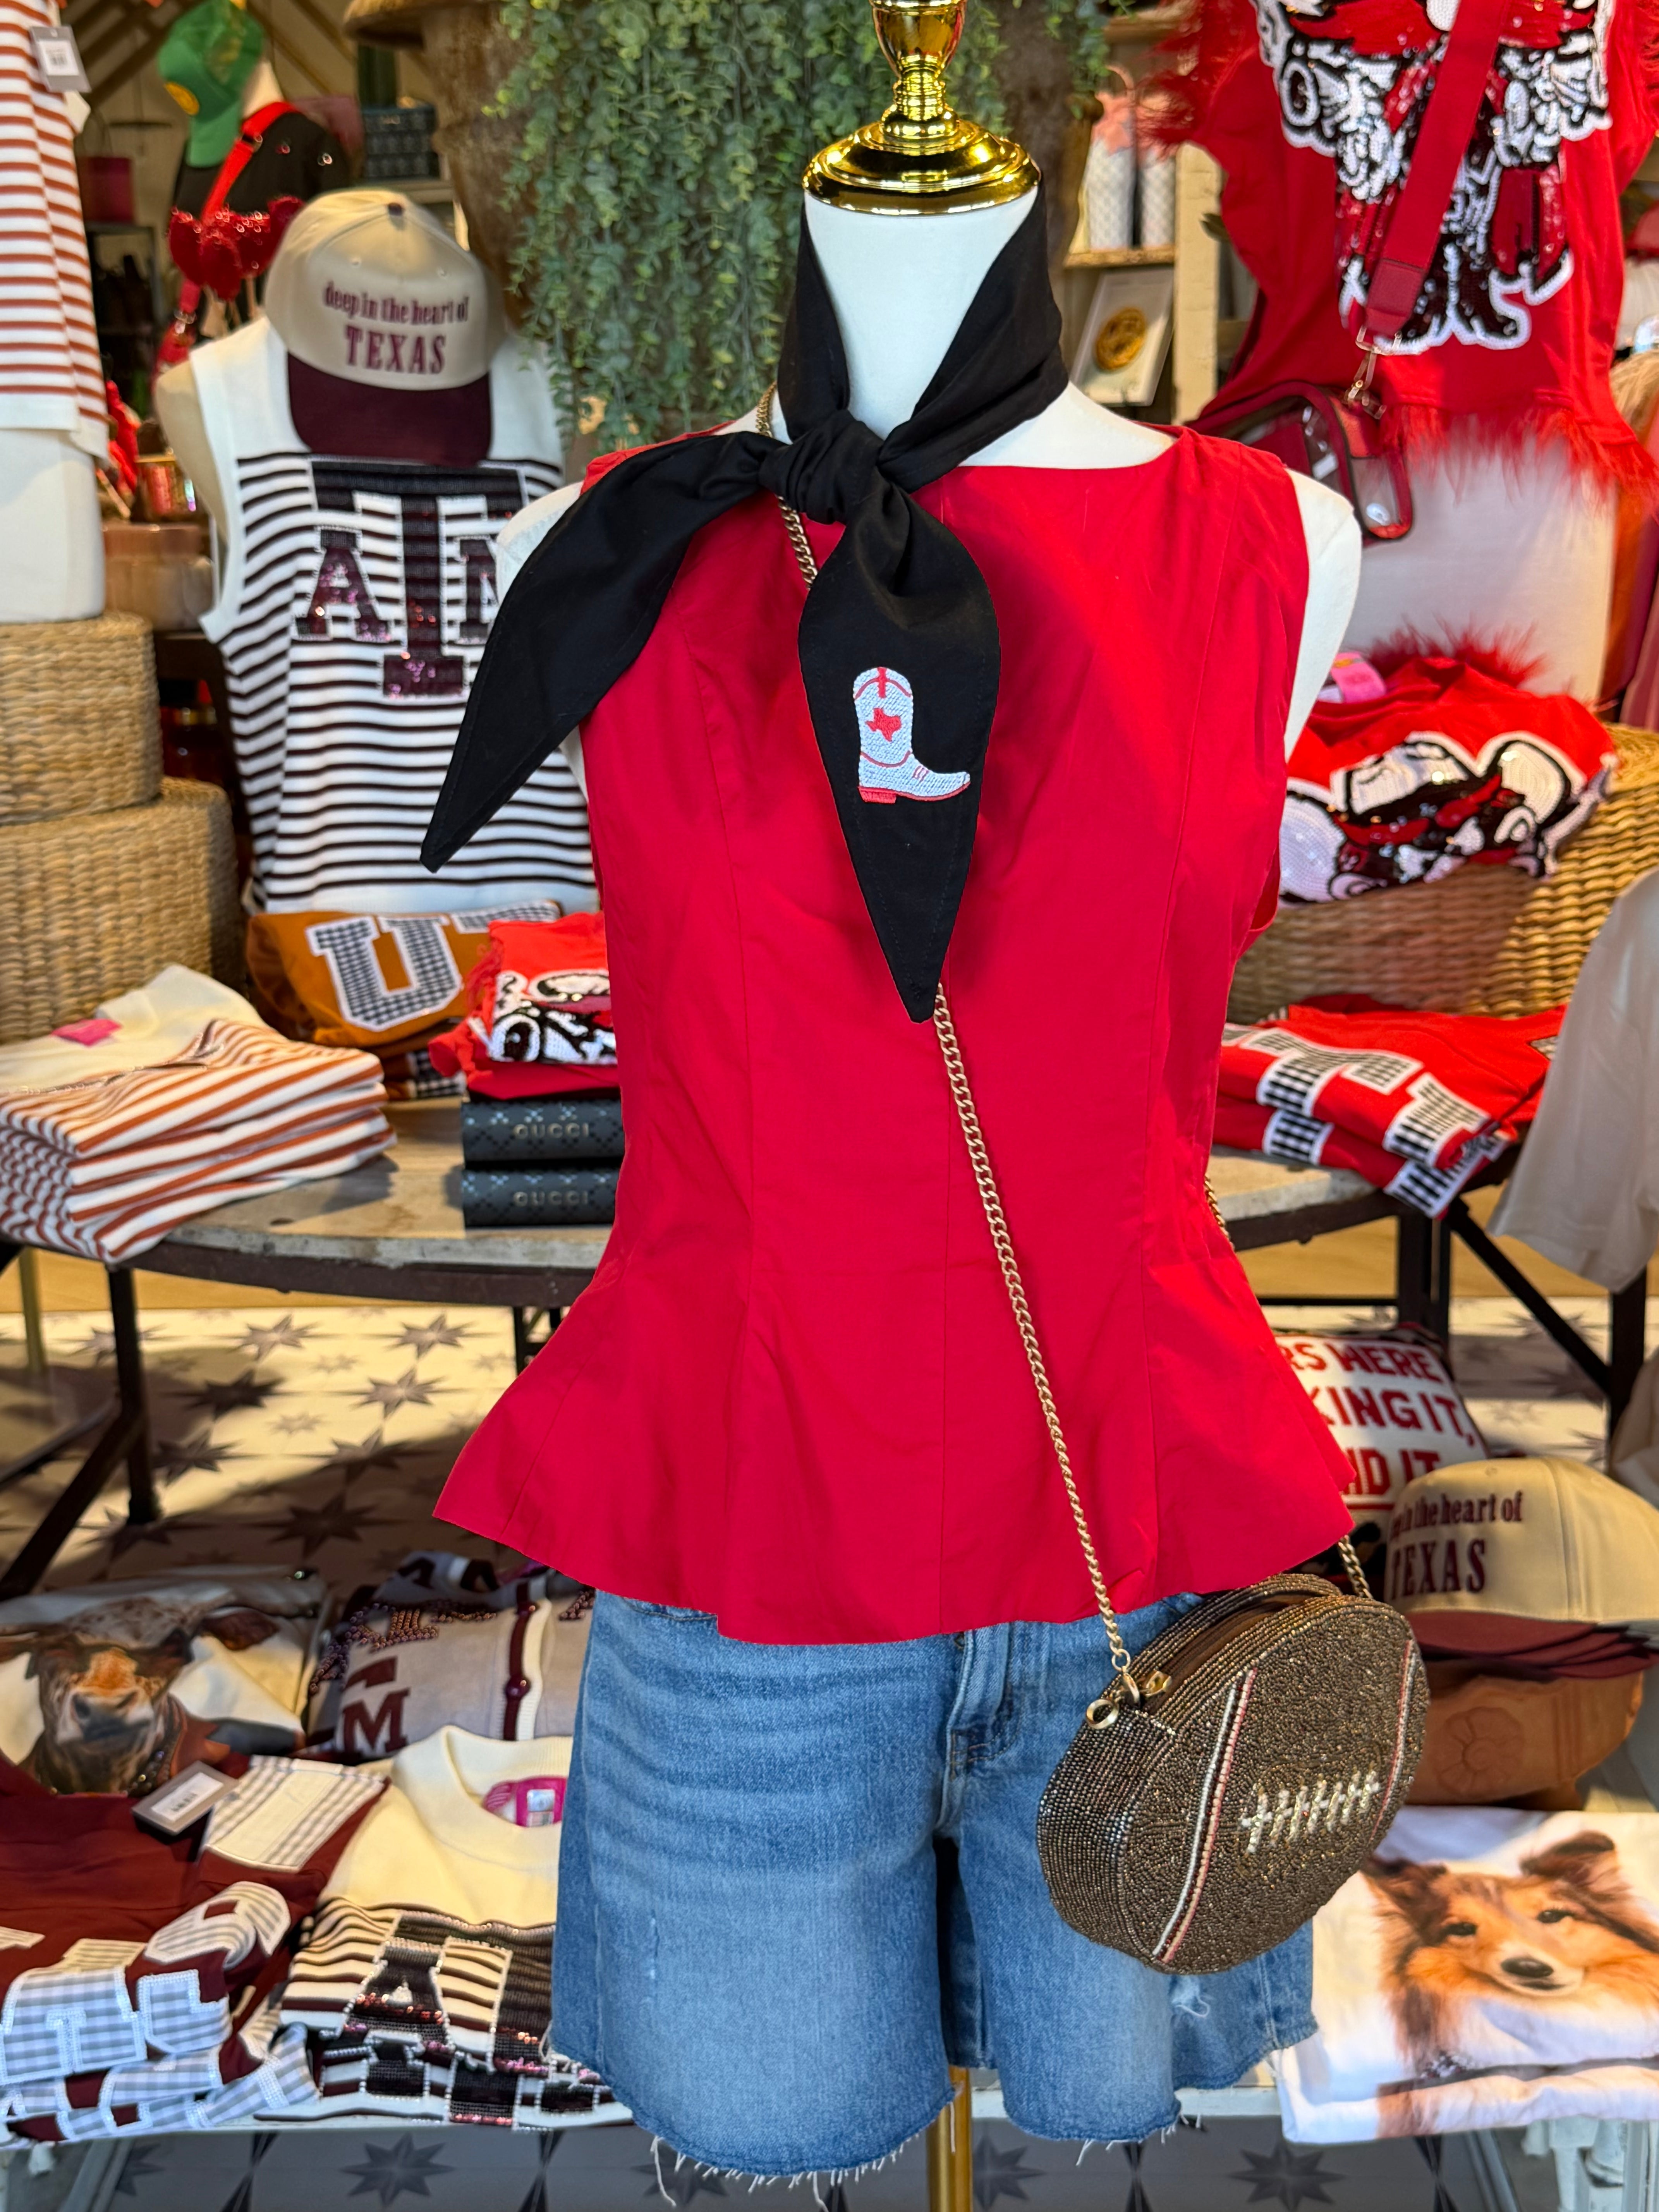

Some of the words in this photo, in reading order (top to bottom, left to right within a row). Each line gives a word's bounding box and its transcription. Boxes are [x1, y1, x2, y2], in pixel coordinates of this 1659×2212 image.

[324, 281, 359, 319] deep
[361, 292, 378, 320] in
[381, 297, 409, 323] the
[411, 299, 454, 325] heart
[345, 325, 447, 374] TEXAS
[512, 1123, 589, 1140] GUCCI
[513, 1190, 589, 1207] GUCCI
[1441, 1492, 1496, 1525] heart
[1500, 1490, 1523, 1522] of
